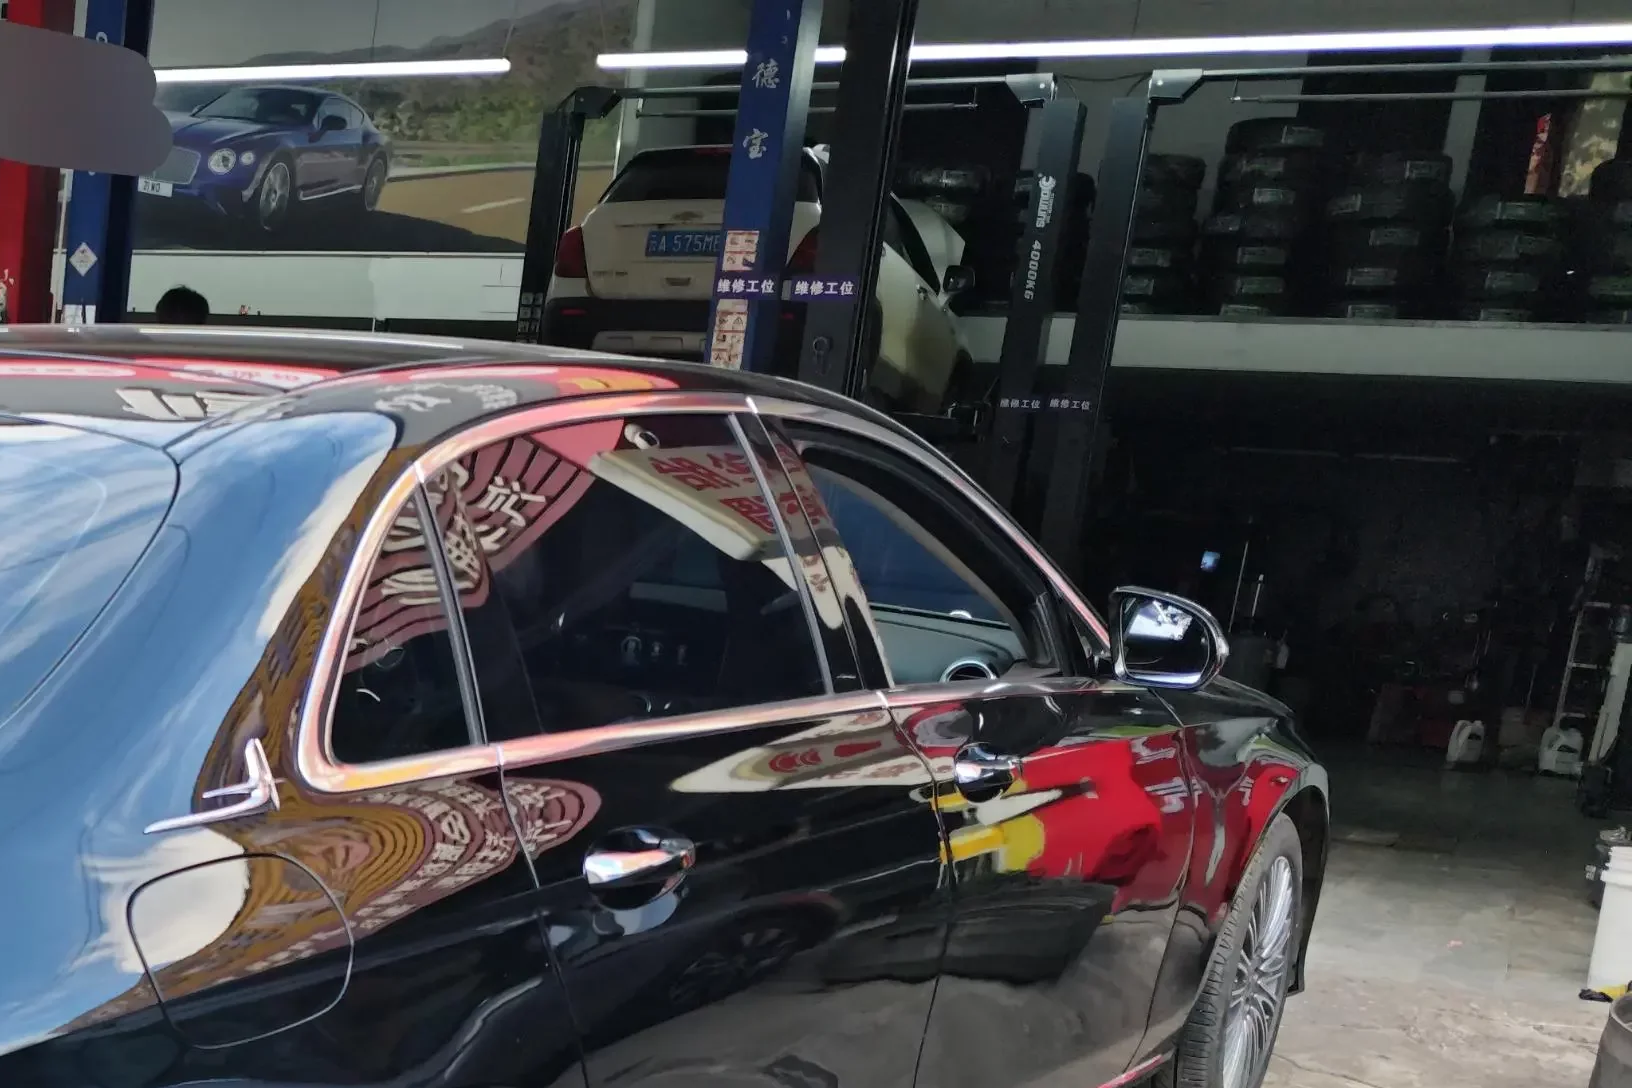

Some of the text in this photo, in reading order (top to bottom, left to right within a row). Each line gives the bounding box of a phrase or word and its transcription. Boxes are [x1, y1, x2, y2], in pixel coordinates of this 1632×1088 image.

[1024, 240, 1042, 301] 4000KG
[717, 278, 775, 295] 维修工位
[794, 280, 855, 296] 维修工位
